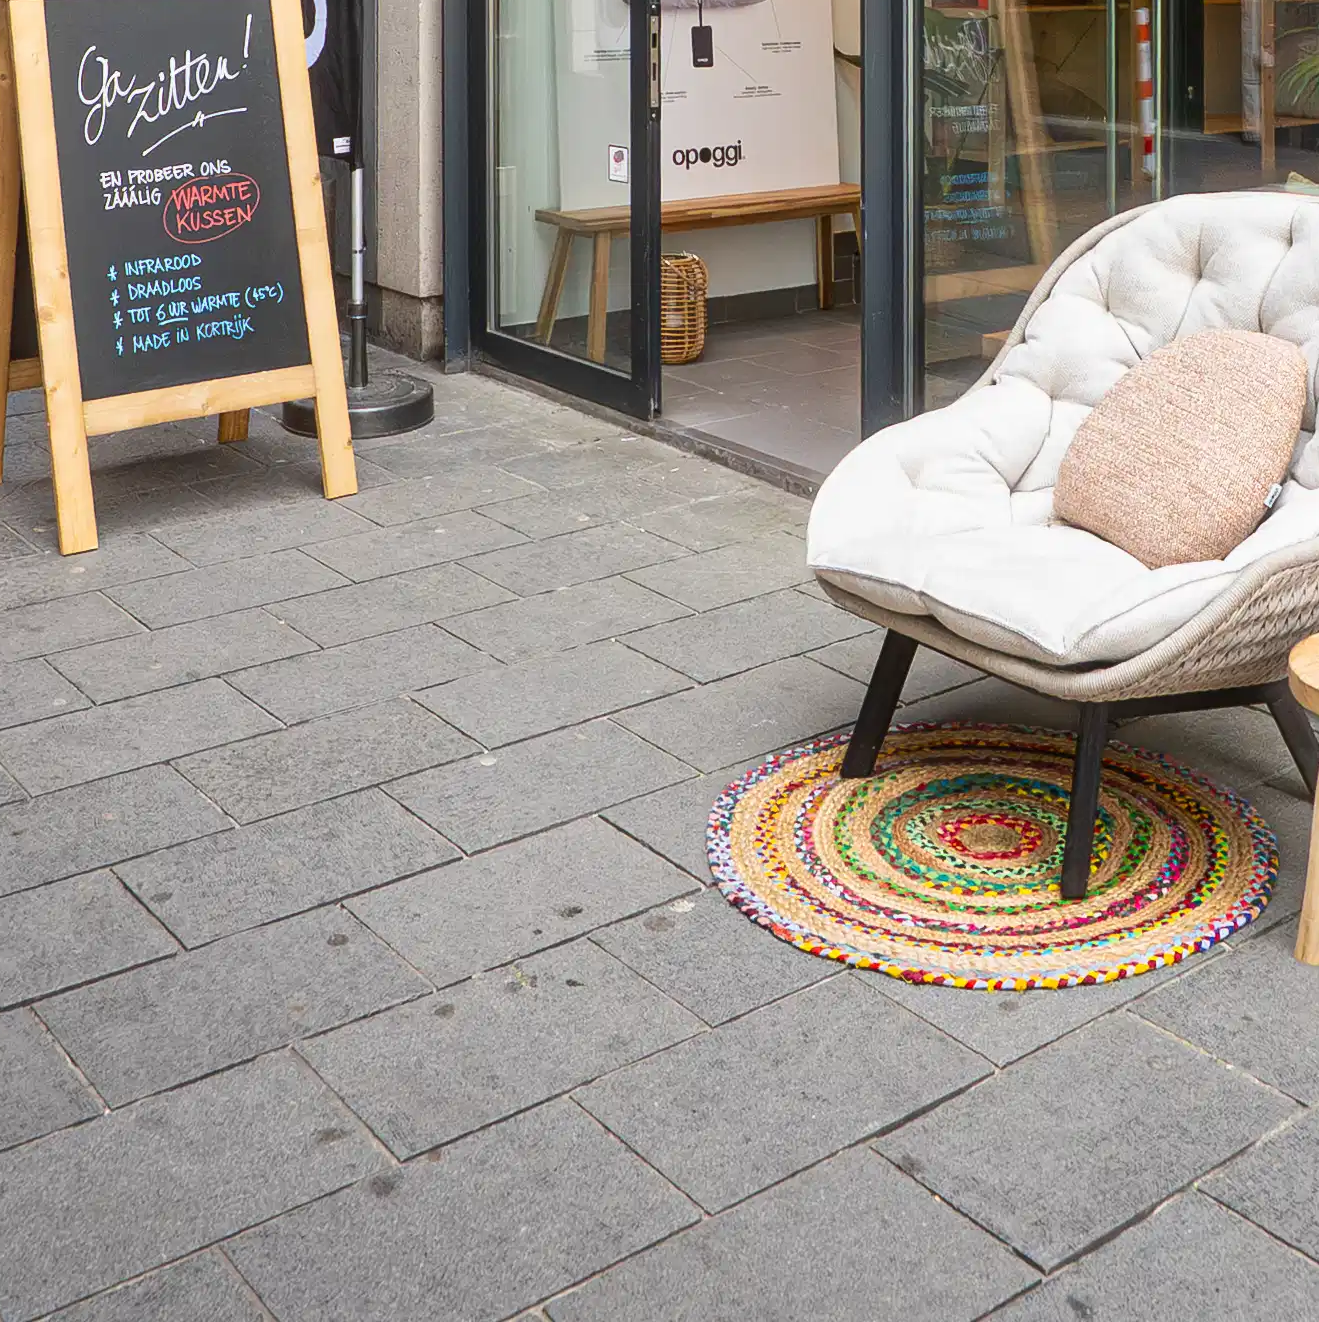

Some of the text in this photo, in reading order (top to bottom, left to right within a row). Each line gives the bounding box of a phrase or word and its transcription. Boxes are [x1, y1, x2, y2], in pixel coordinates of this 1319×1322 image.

[77, 13, 253, 146] Ga zitten!
[672, 139, 743, 171] opoggi
[99, 159, 232, 189] EN PROBEER ONS
[171, 180, 252, 211] WARMTE
[175, 204, 253, 234] KUSSEN
[124, 253, 202, 277] INFRAROOD
[127, 276, 202, 301] DRAADLOOS
[127, 306, 152, 324] TOT
[155, 303, 167, 321] 6
[190, 291, 241, 314] WARMTE
[132, 331, 172, 353] MADE
